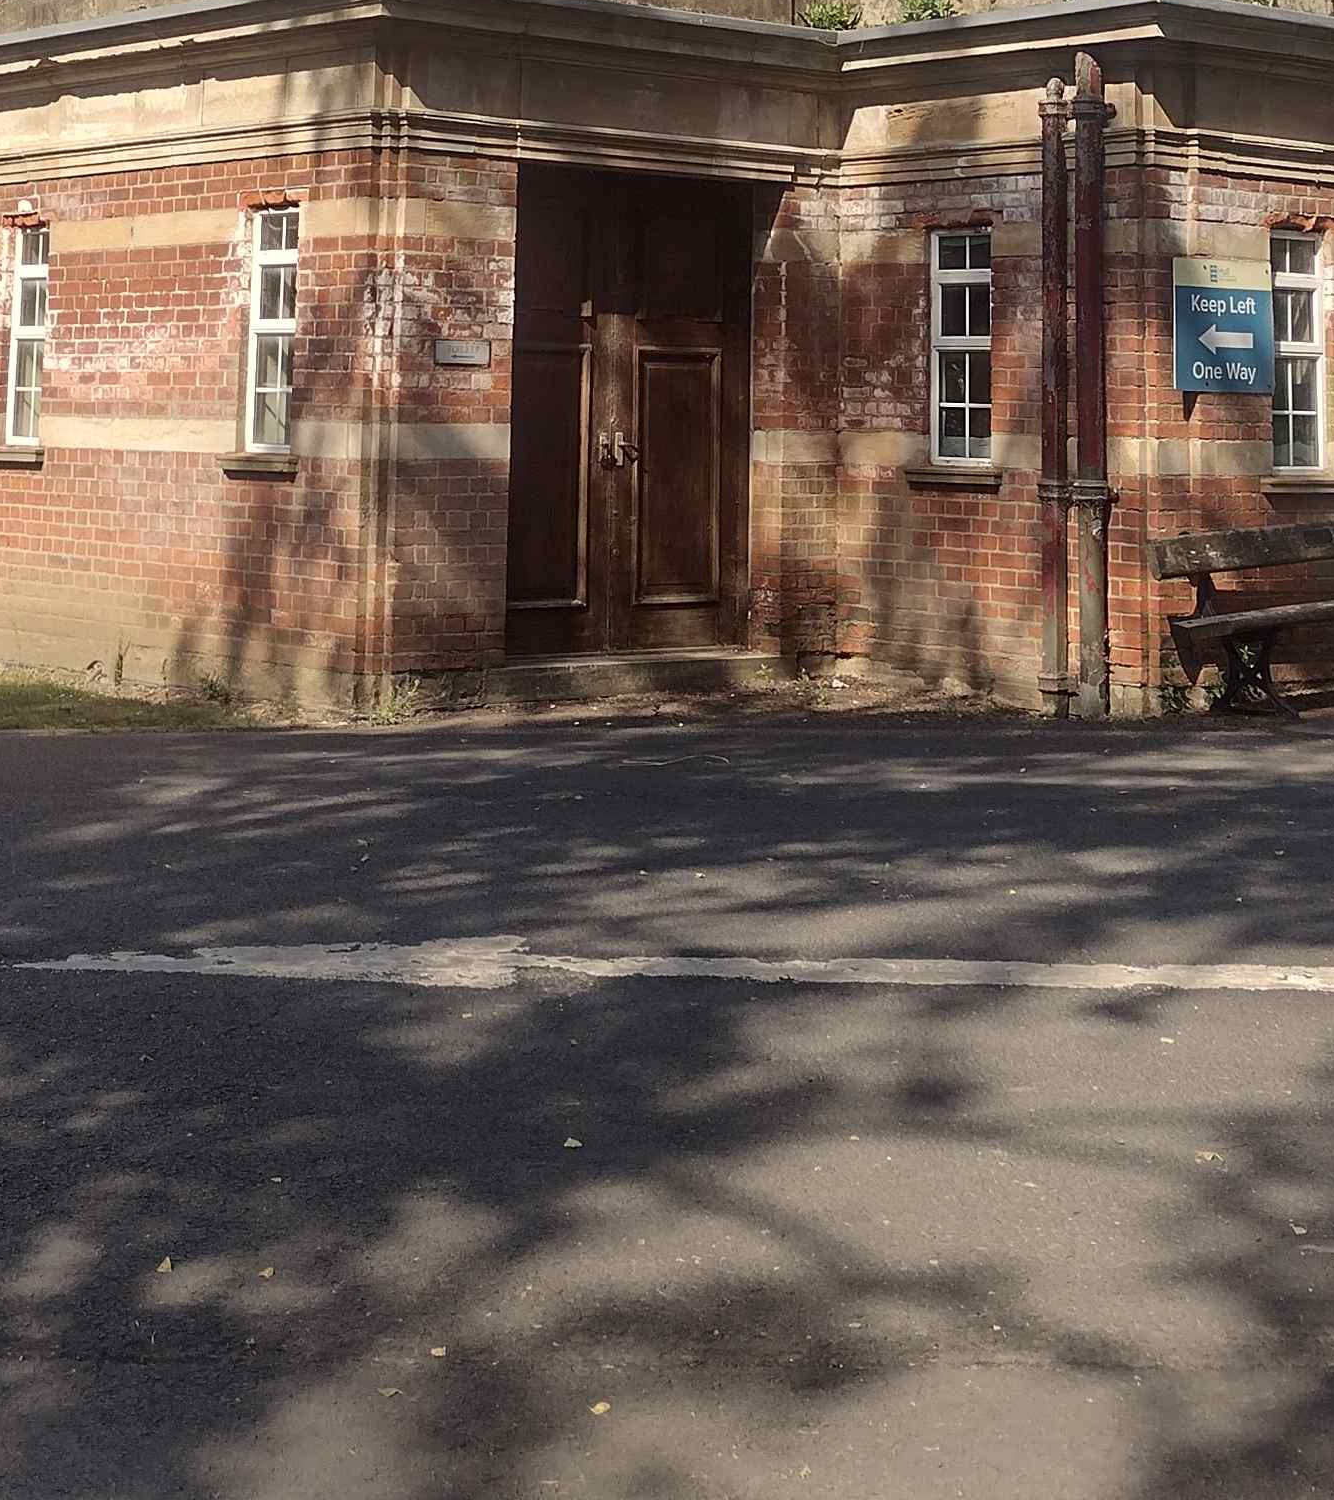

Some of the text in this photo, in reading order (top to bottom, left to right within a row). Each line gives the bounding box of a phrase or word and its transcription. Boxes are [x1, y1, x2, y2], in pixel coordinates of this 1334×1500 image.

[1191, 294, 1256, 316] Keep Left
[1192, 361, 1257, 385] One Way
